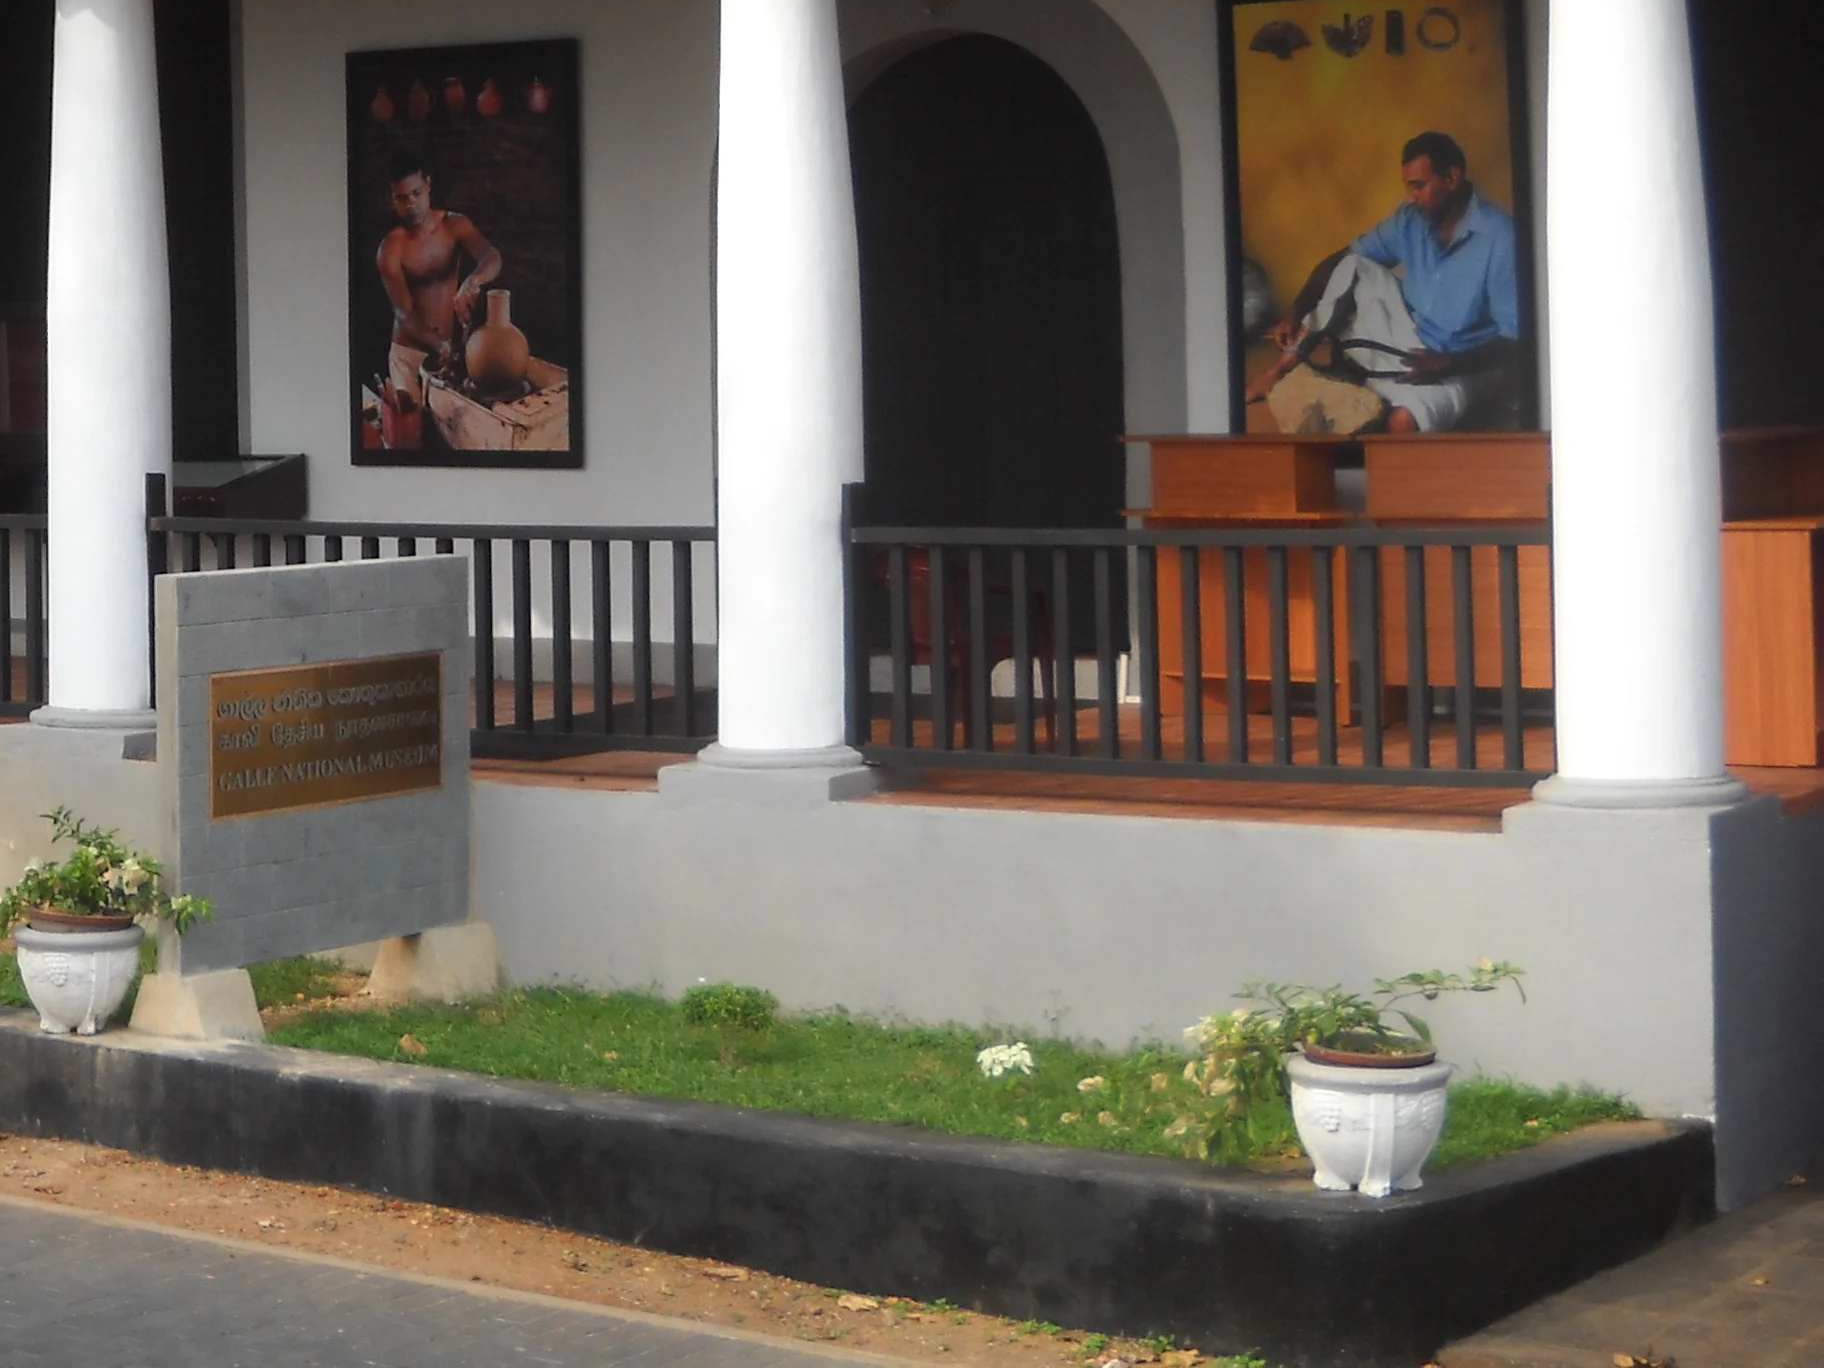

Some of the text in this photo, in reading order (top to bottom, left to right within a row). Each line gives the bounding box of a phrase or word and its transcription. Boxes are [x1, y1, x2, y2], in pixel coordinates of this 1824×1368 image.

[218, 743, 439, 792] GALLE NATIONAL MUSEUM
